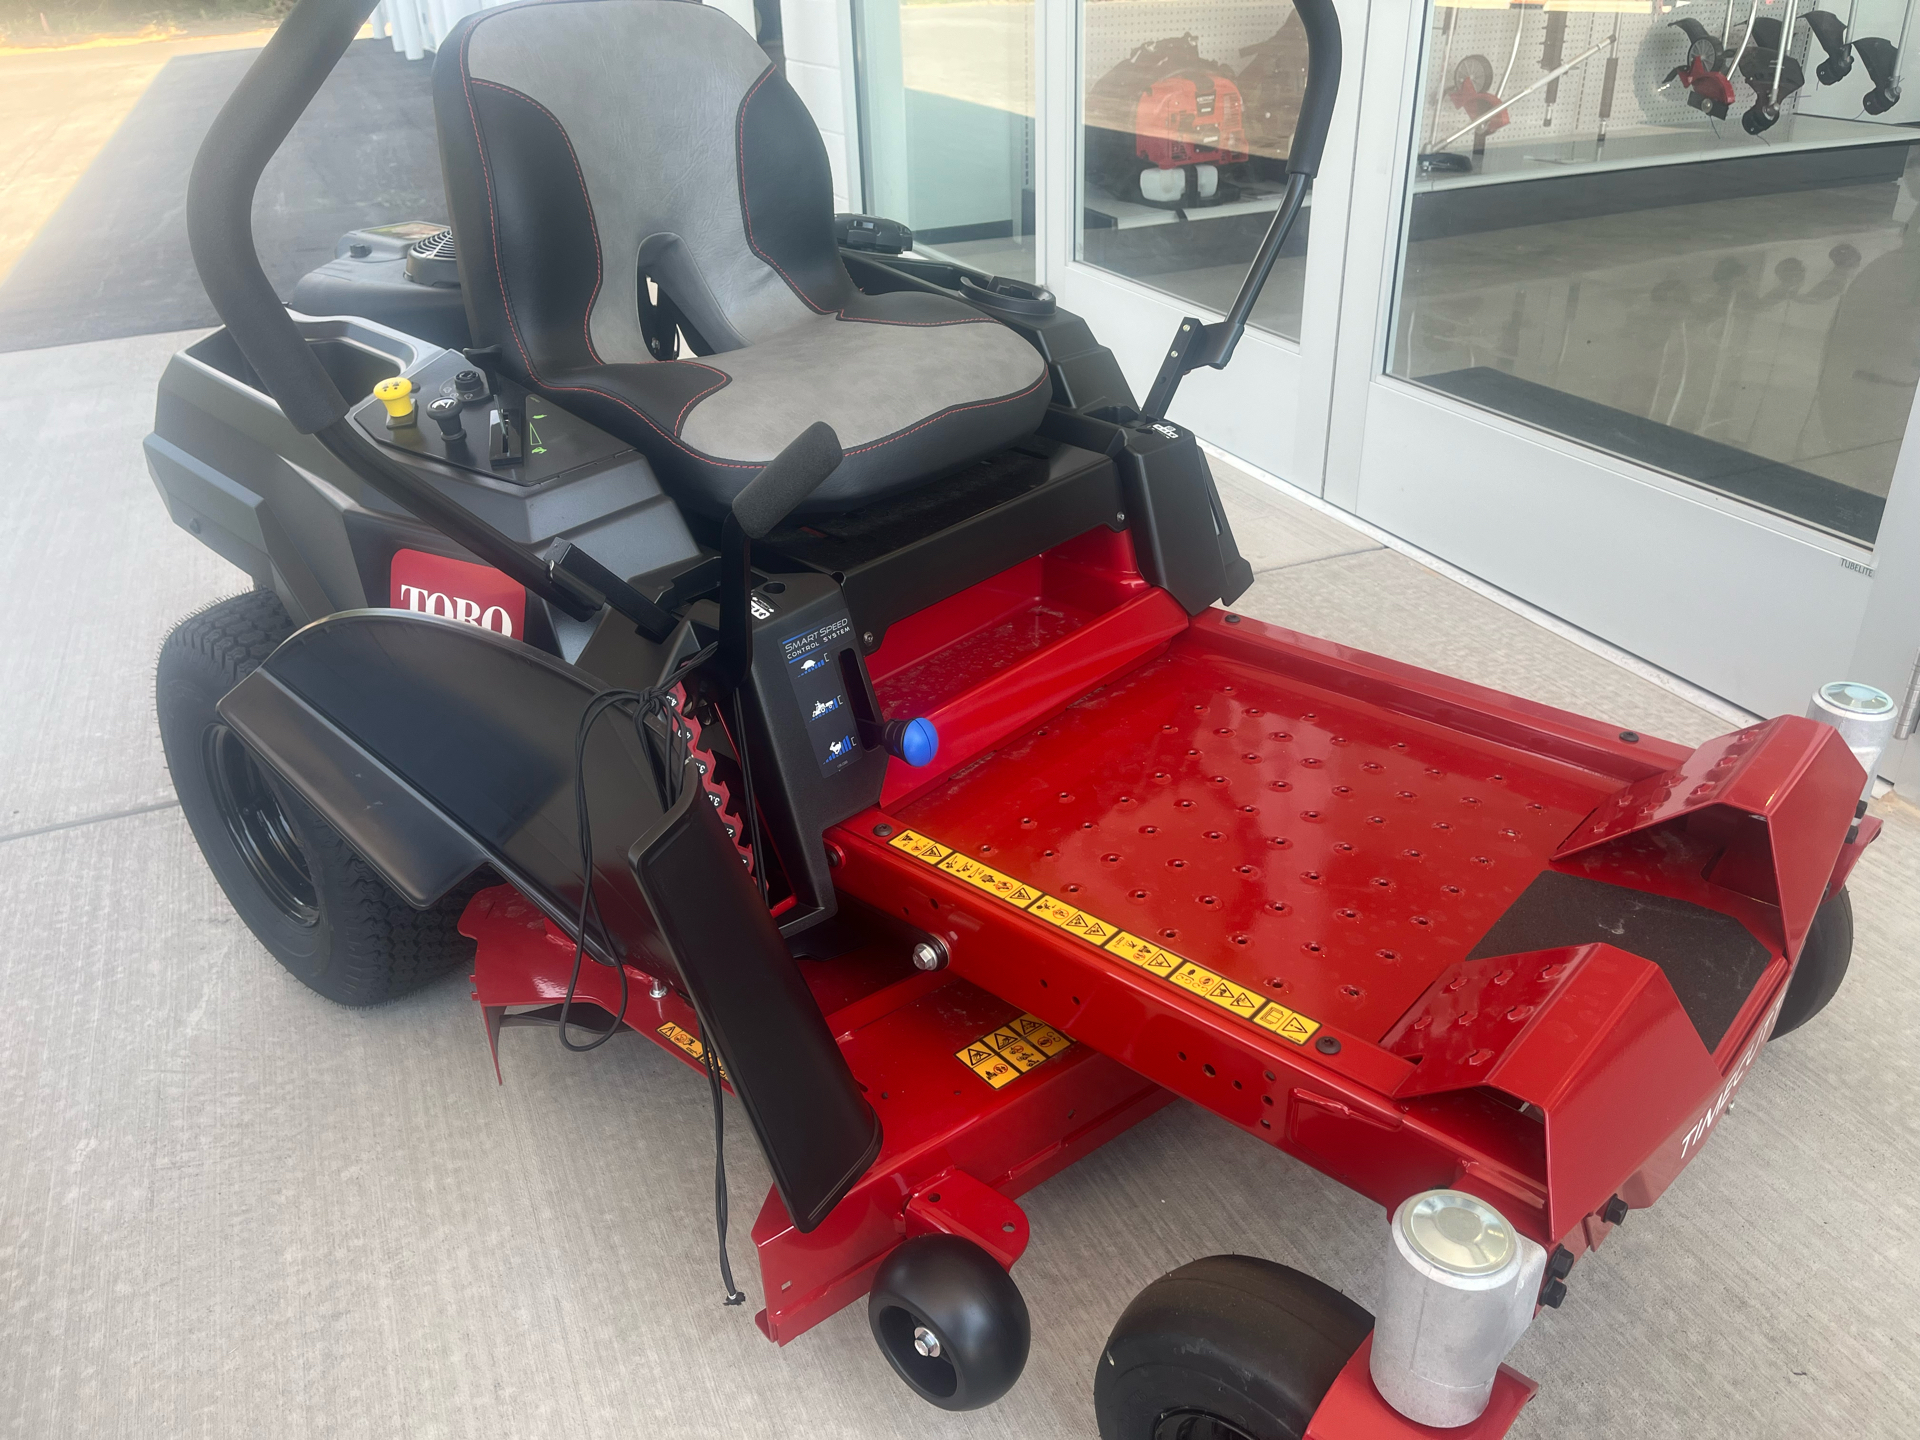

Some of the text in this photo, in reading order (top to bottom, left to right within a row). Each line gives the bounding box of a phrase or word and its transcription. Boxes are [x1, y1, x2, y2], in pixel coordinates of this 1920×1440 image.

[1840, 557, 1873, 578] TUBELITE
[400, 584, 513, 638] TORO
[784, 618, 848, 653] SMART SPEED
[786, 626, 850, 660] CONTROL SYSTEM
